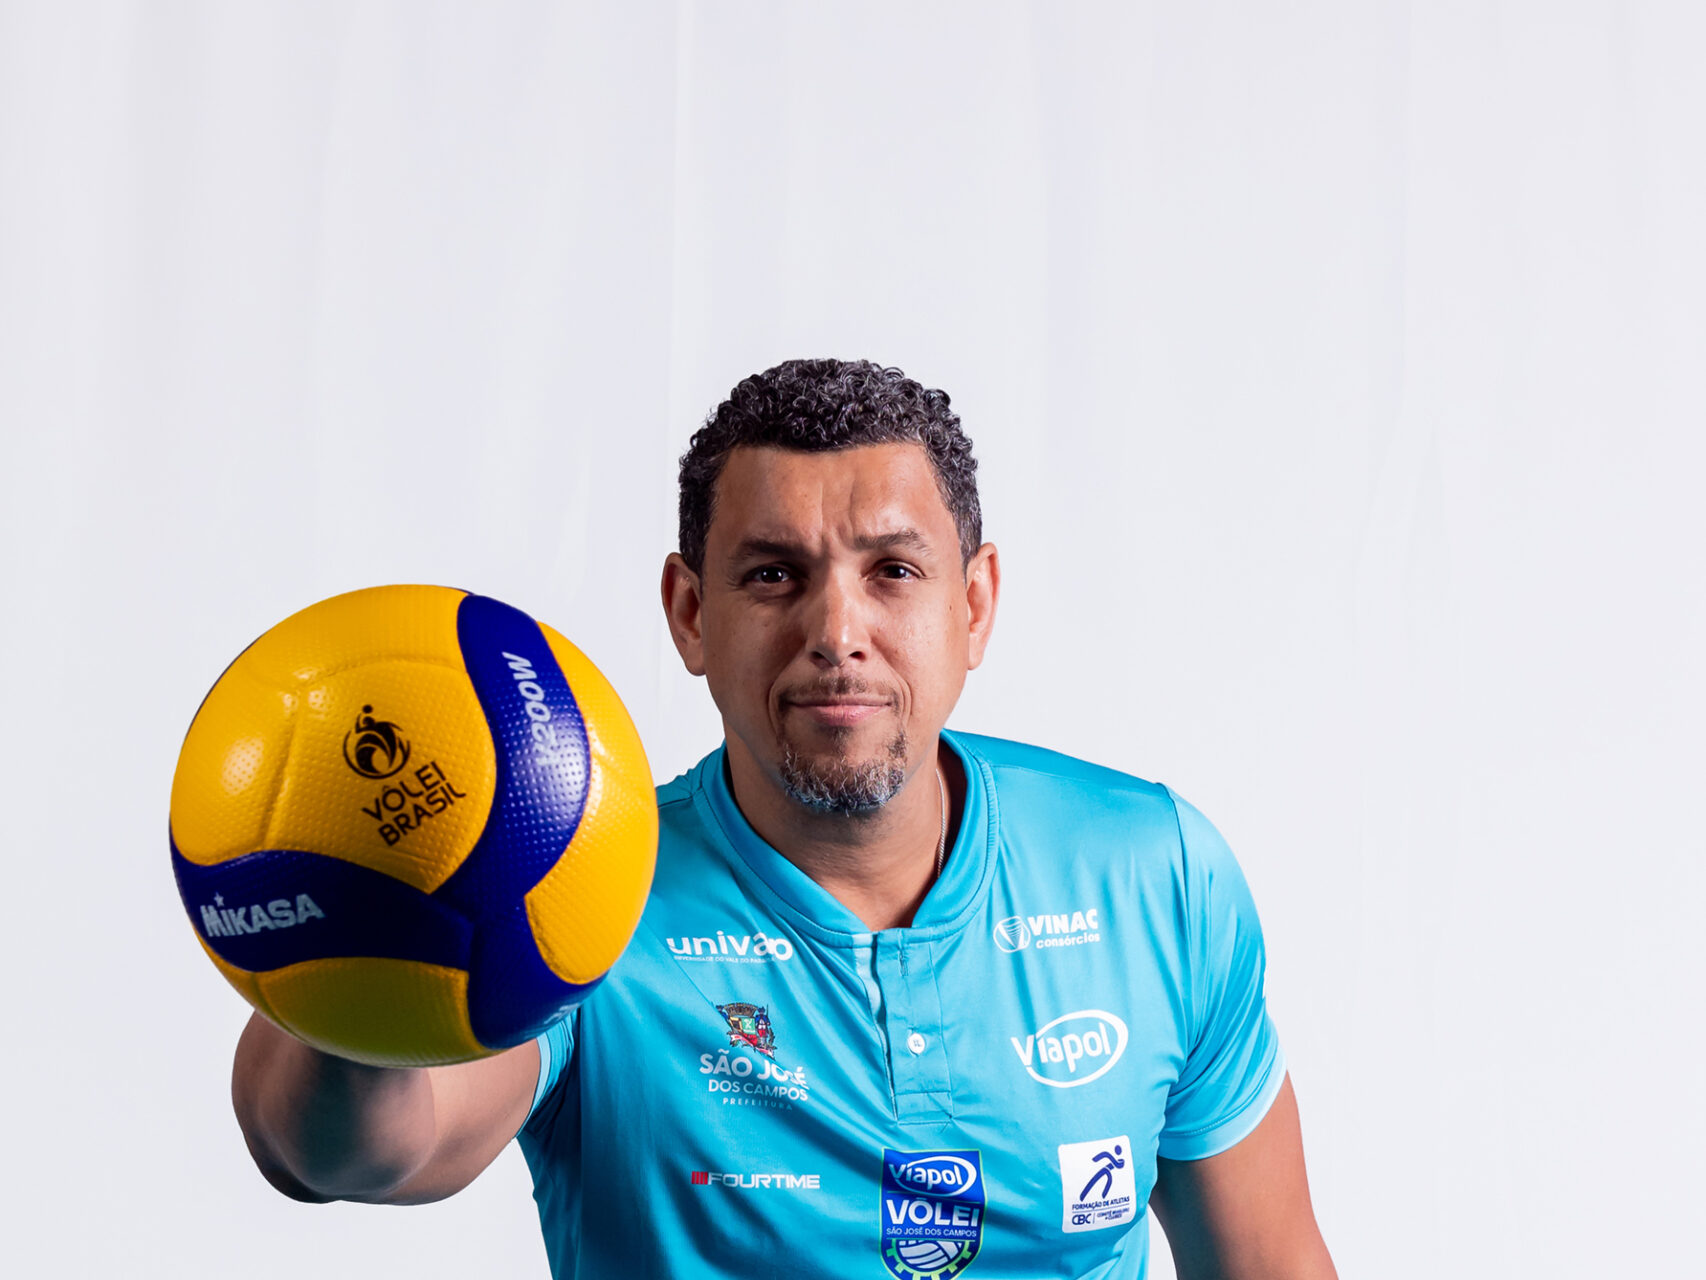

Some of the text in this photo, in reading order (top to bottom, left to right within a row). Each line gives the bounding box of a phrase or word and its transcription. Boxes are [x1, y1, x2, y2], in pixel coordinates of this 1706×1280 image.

[501, 651, 560, 766] V200W
[362, 761, 446, 822] VÔLEI
[378, 782, 466, 846] BRASIL
[200, 893, 325, 937] MIKASA
[1027, 908, 1098, 936] VINAC
[1035, 932, 1100, 949] consórcios
[1011, 1022, 1111, 1073] Viapol
[699, 1048, 809, 1090] SÃO JOSÉ
[709, 1079, 808, 1101] DOS CAMPOS
[723, 1098, 792, 1111] PREFEITURA
[707, 1172, 820, 1189] FOURTIME
[888, 1163, 963, 1190] Viapol
[1071, 1212, 1092, 1225] CBC
[1072, 1200, 1102, 1210] FORMAÇÃO
[886, 1226, 977, 1237] SÃO JOSÉ DOS CAMPOS
